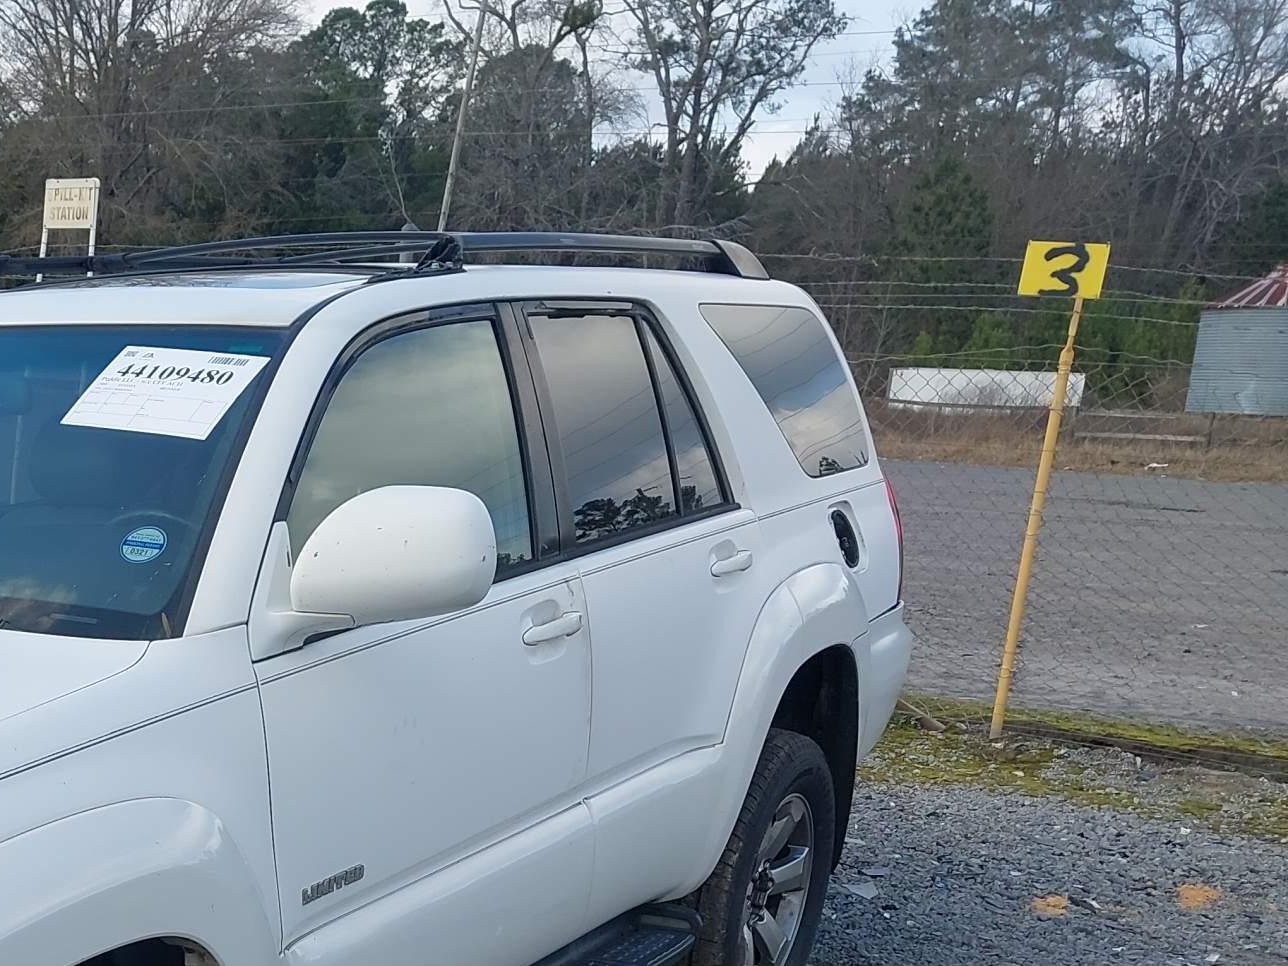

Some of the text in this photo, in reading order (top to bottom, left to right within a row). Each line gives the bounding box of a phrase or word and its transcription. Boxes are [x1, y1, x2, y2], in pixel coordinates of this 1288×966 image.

[47, 187, 94, 201] PILL-KT
[48, 206, 89, 220] STATION
[1038, 244, 1089, 297] 3
[116, 362, 234, 386] 44109480
[301, 863, 365, 906] LIMITED
